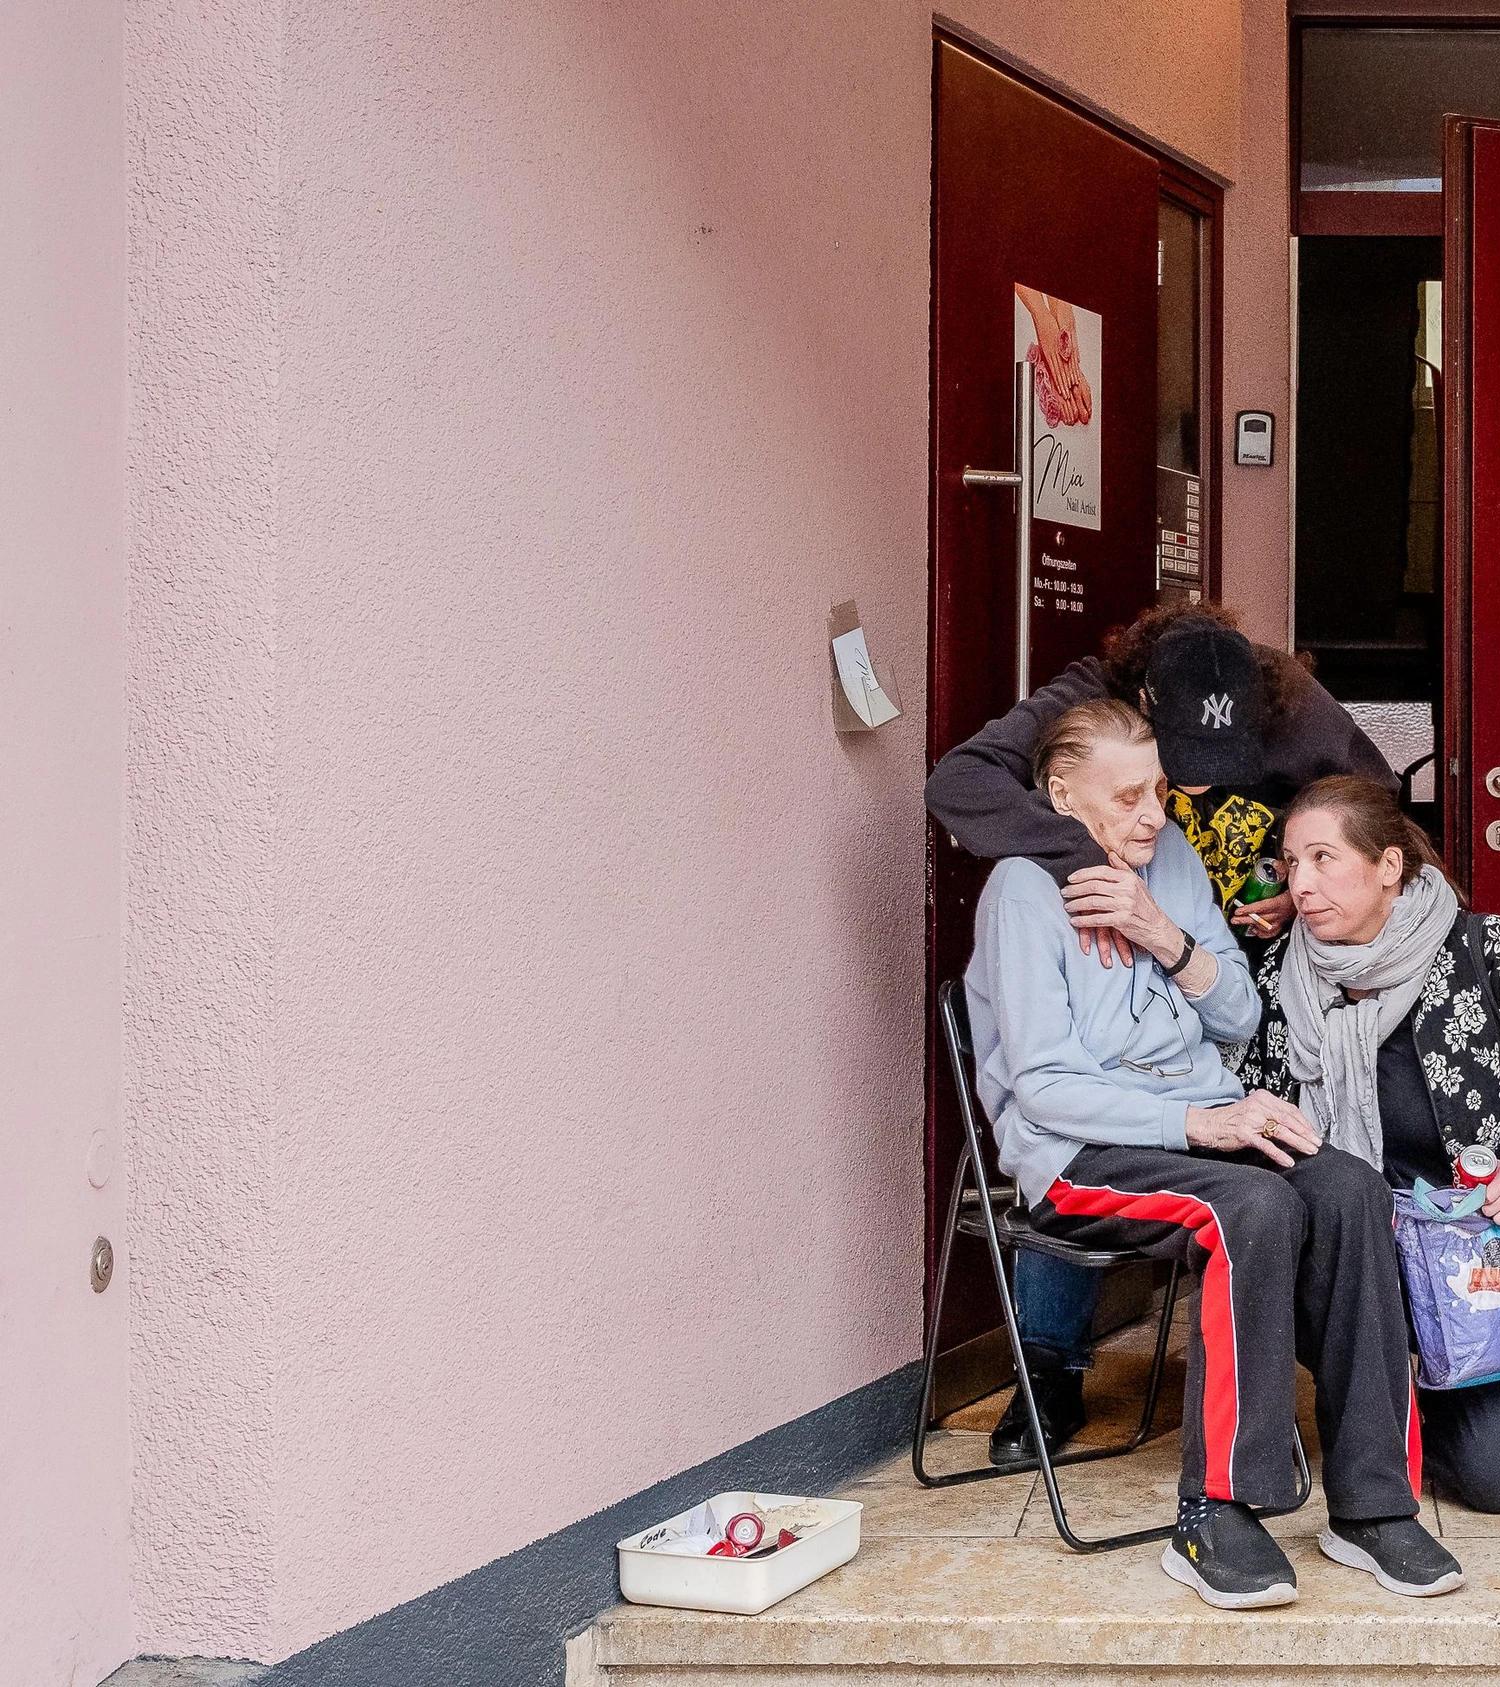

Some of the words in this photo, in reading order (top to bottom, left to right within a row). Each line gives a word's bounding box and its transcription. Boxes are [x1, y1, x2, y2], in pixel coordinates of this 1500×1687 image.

[1034, 434, 1084, 504] Mia
[1066, 497, 1079, 512] Nail
[1081, 501, 1096, 516] Artist
[1042, 553, 1077, 571] Öffnungszeiten
[1201, 693, 1233, 729] NY
[640, 1528, 667, 1549] Code
